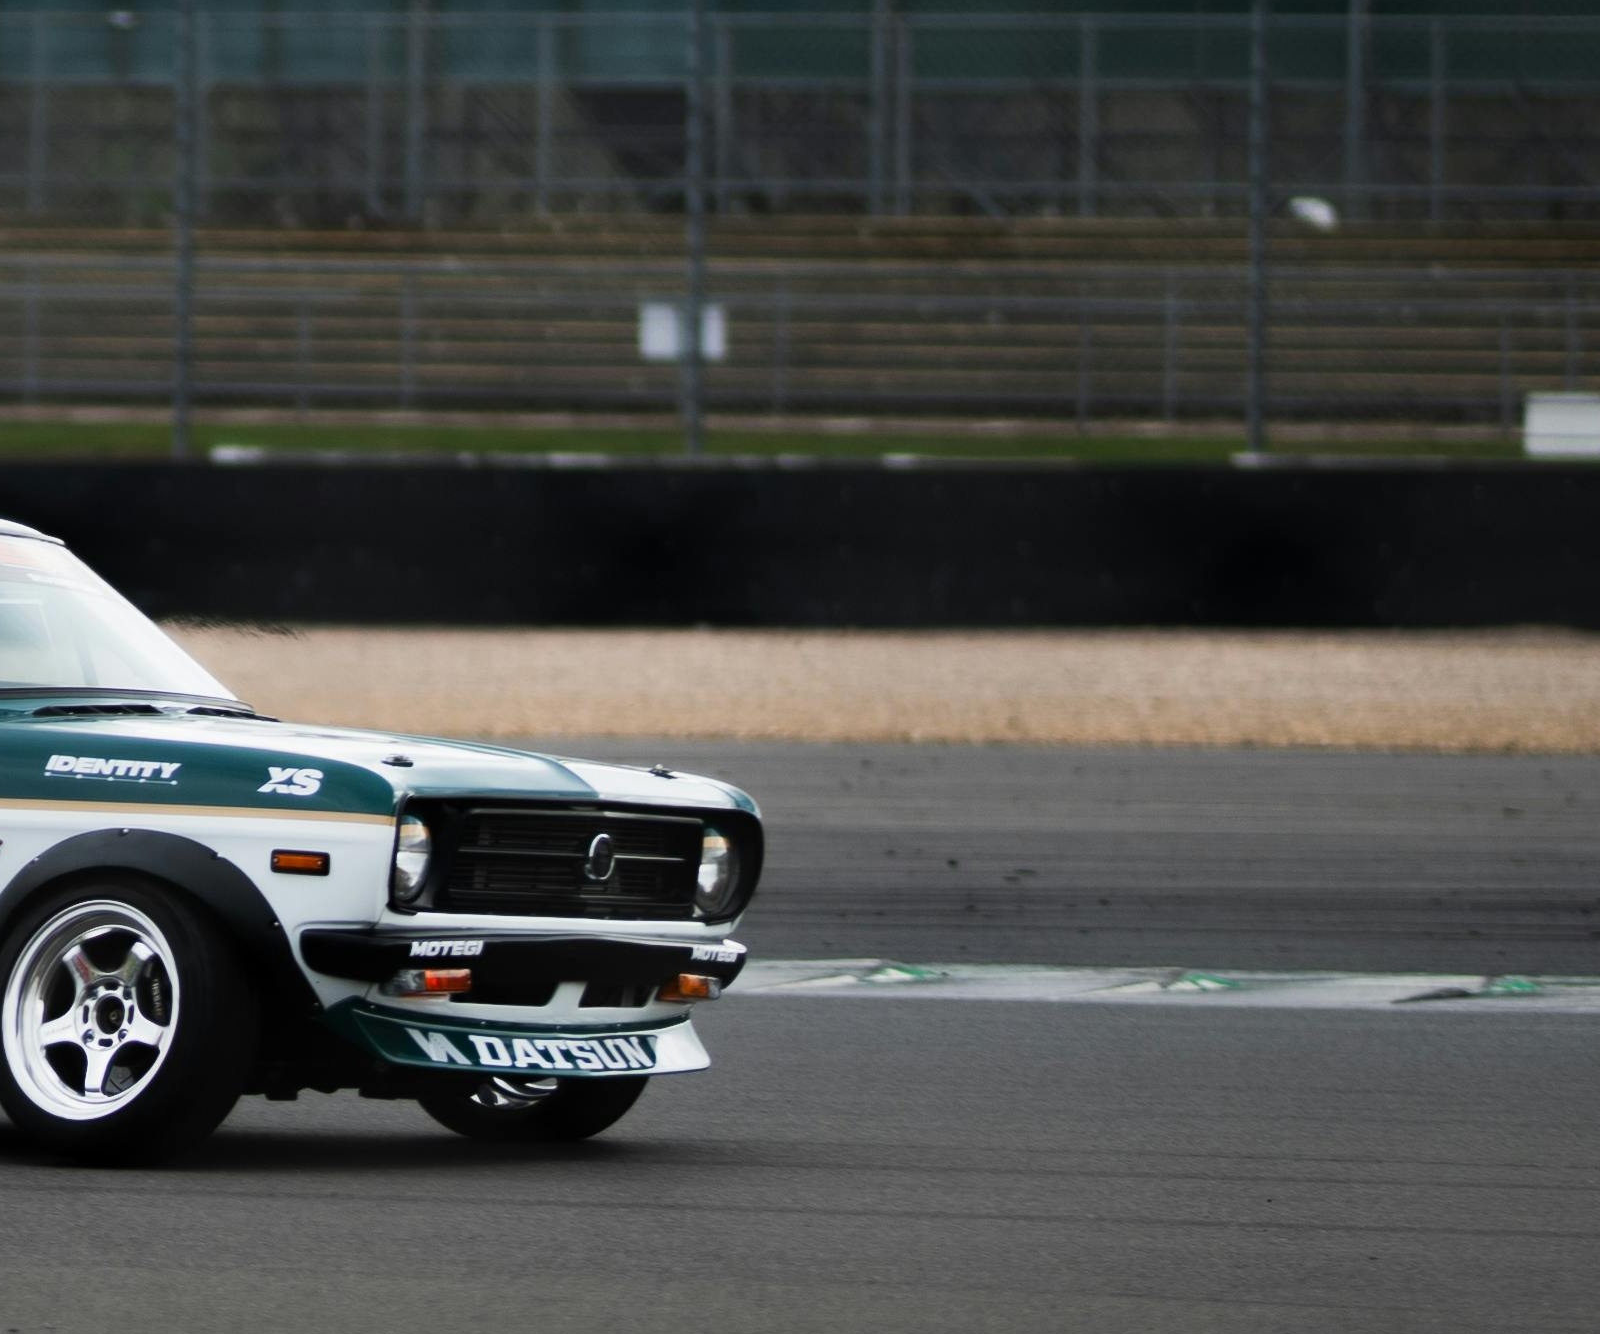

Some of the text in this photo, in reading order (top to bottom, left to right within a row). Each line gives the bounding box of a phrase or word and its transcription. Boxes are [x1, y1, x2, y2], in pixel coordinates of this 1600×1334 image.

[45, 754, 183, 779] IDENTITY
[256, 766, 324, 796] XS
[409, 940, 484, 957] MOTEGI
[691, 945, 738, 963] MOTEGI
[468, 1034, 656, 1069] DATSUN
